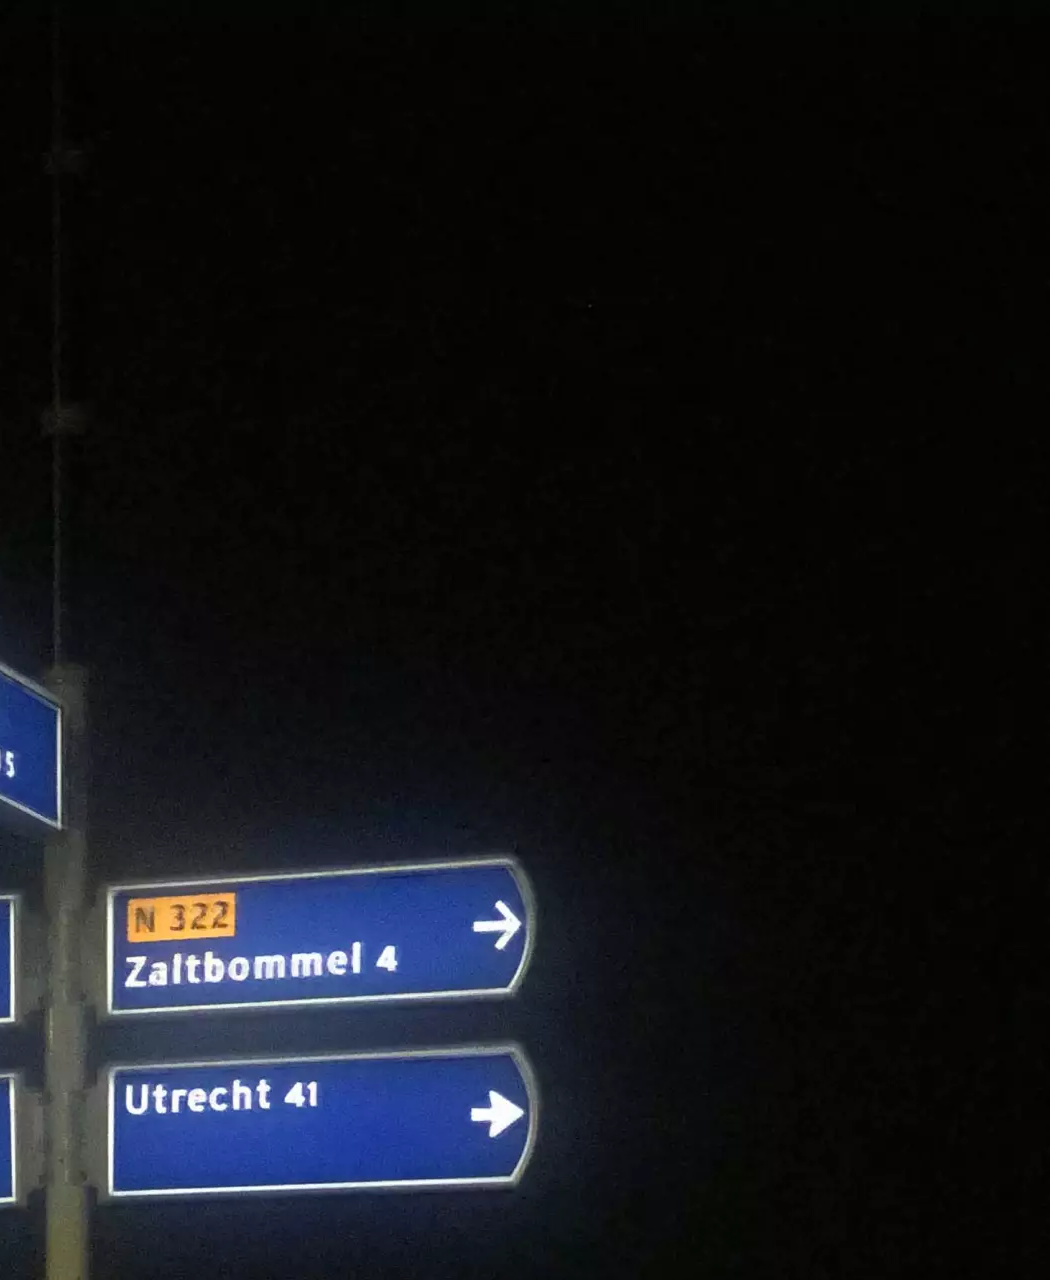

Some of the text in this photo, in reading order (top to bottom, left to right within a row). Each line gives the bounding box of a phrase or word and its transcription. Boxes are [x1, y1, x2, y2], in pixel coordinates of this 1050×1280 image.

[5, 752, 15, 778] 5
[134, 901, 231, 933] N 322
[124, 941, 398, 988] Zaltbommel 4
[124, 1079, 319, 1115] Utrecht 41
